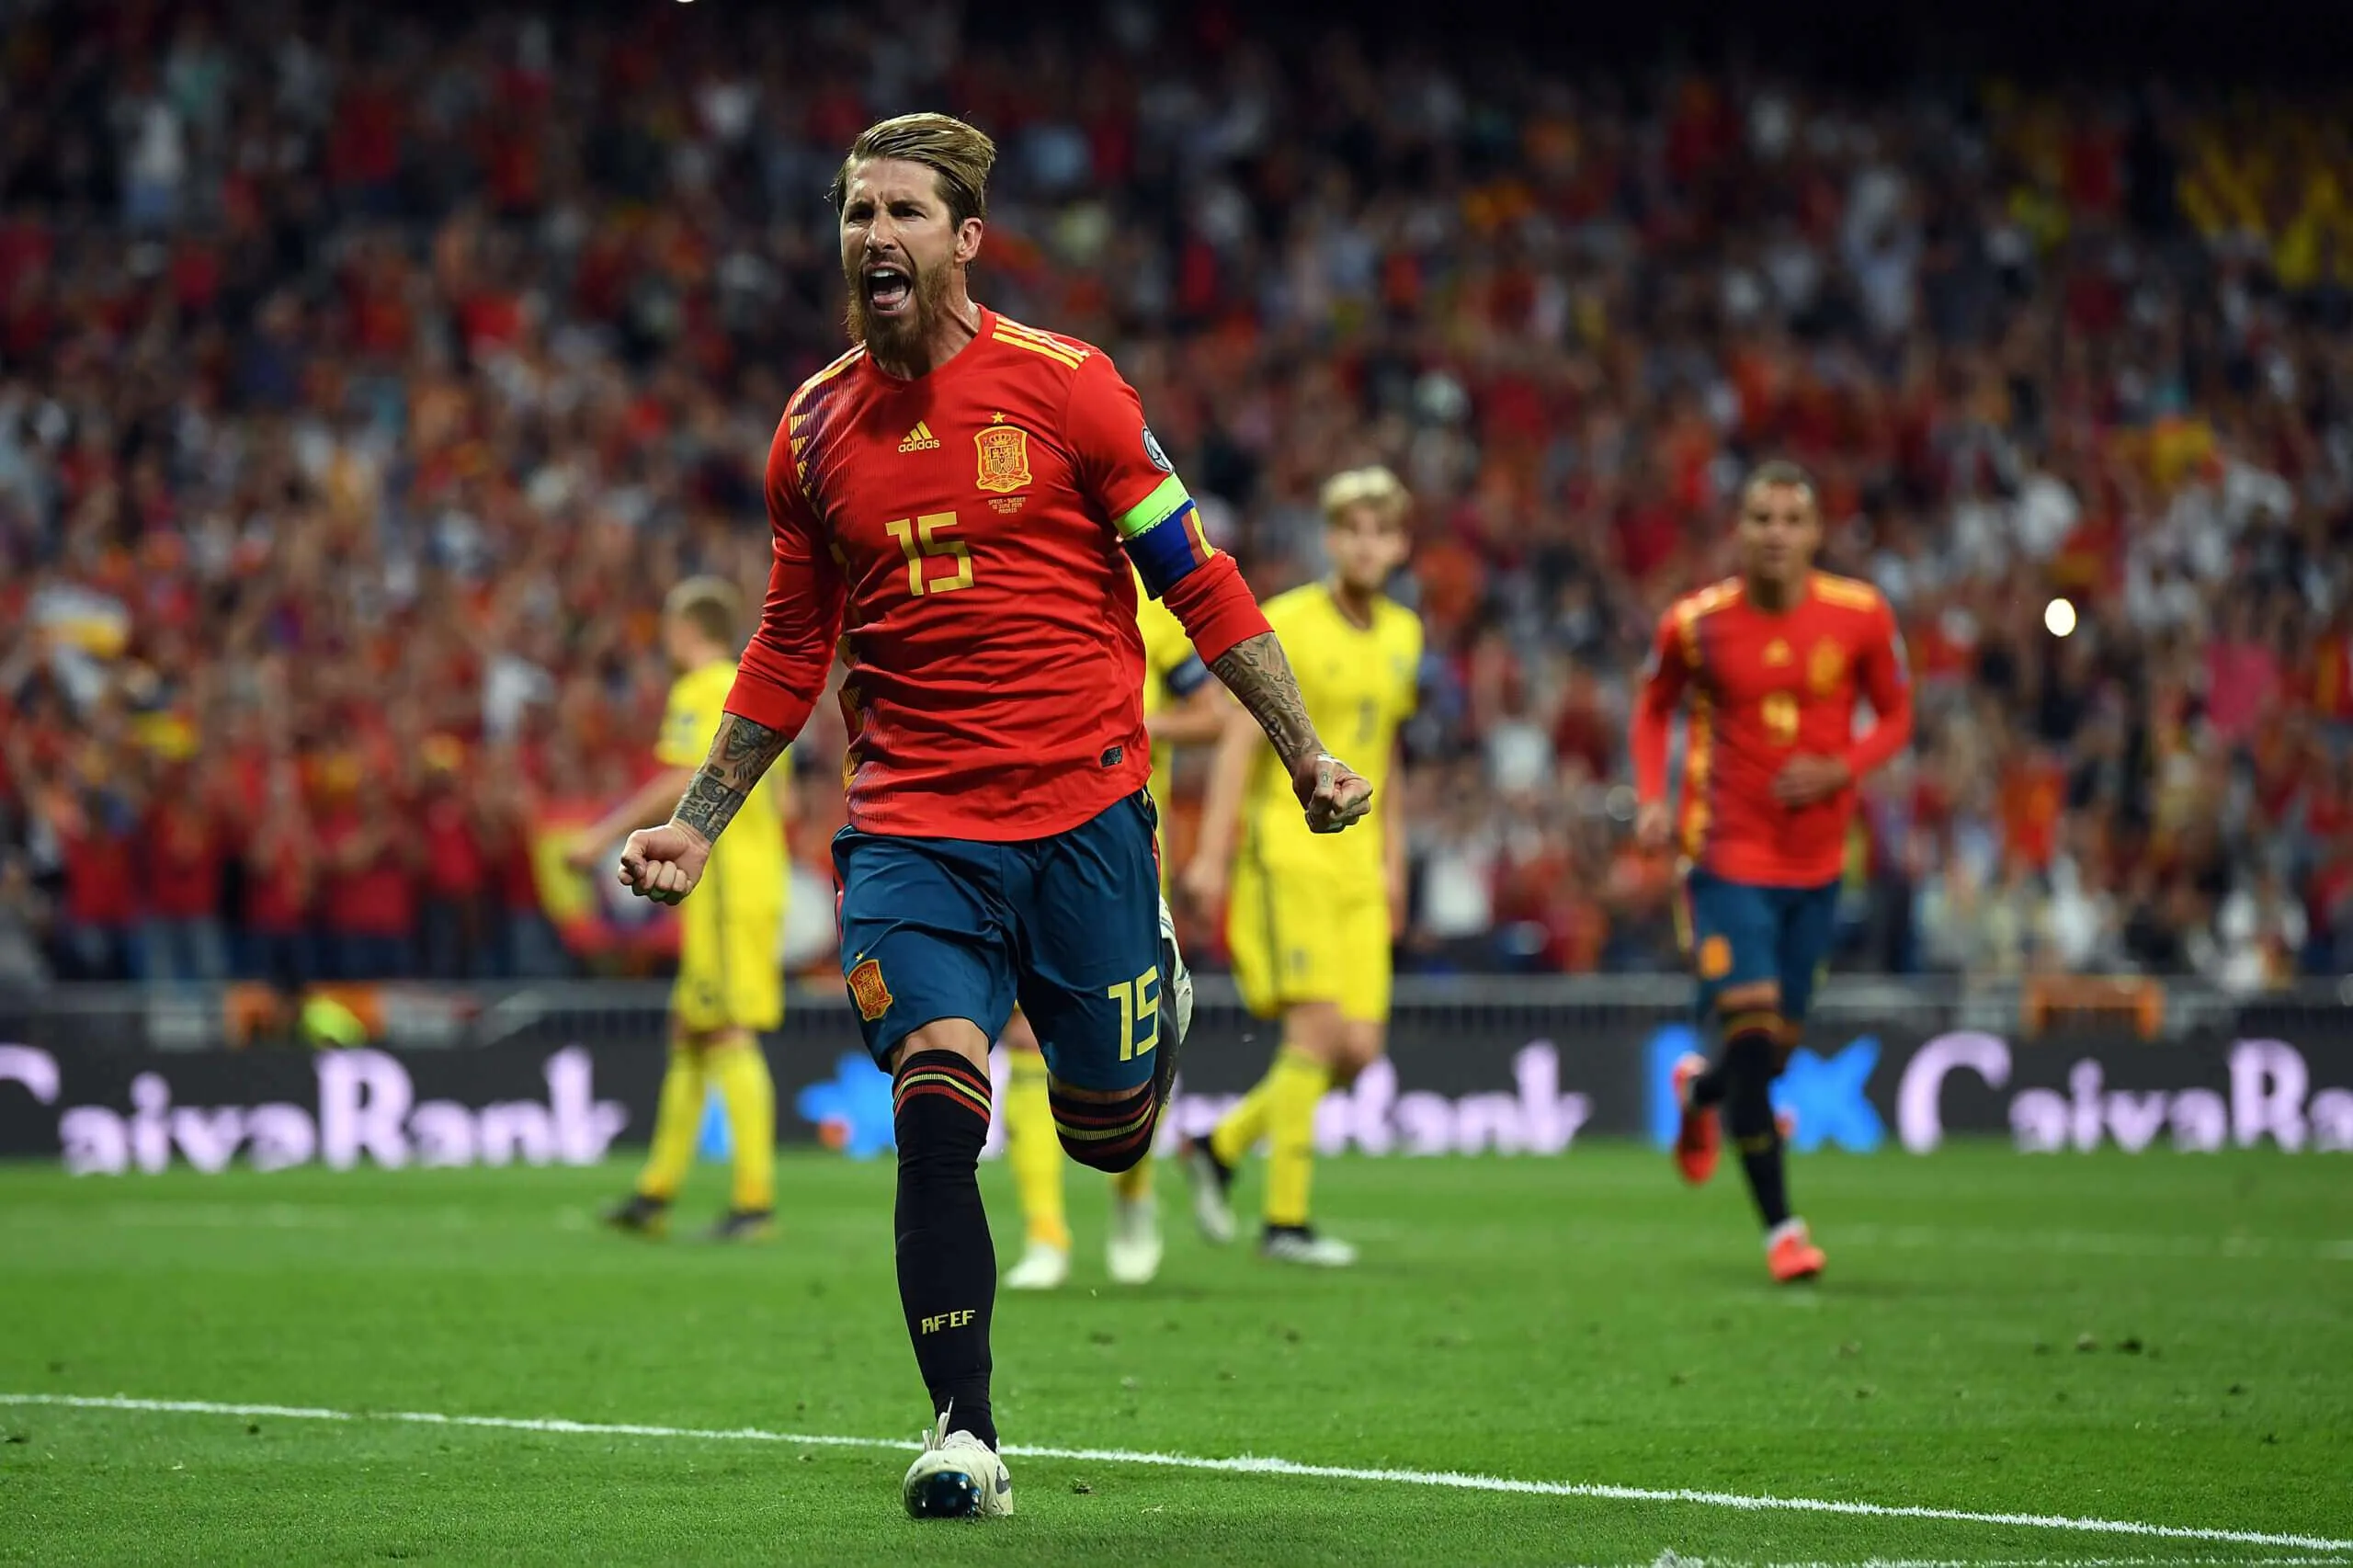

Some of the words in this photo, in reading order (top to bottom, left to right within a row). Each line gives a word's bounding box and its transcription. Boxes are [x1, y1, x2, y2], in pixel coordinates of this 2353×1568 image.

[898, 439, 940, 453] adidas
[885, 511, 974, 597] 15
[1108, 965, 1161, 1062] 15
